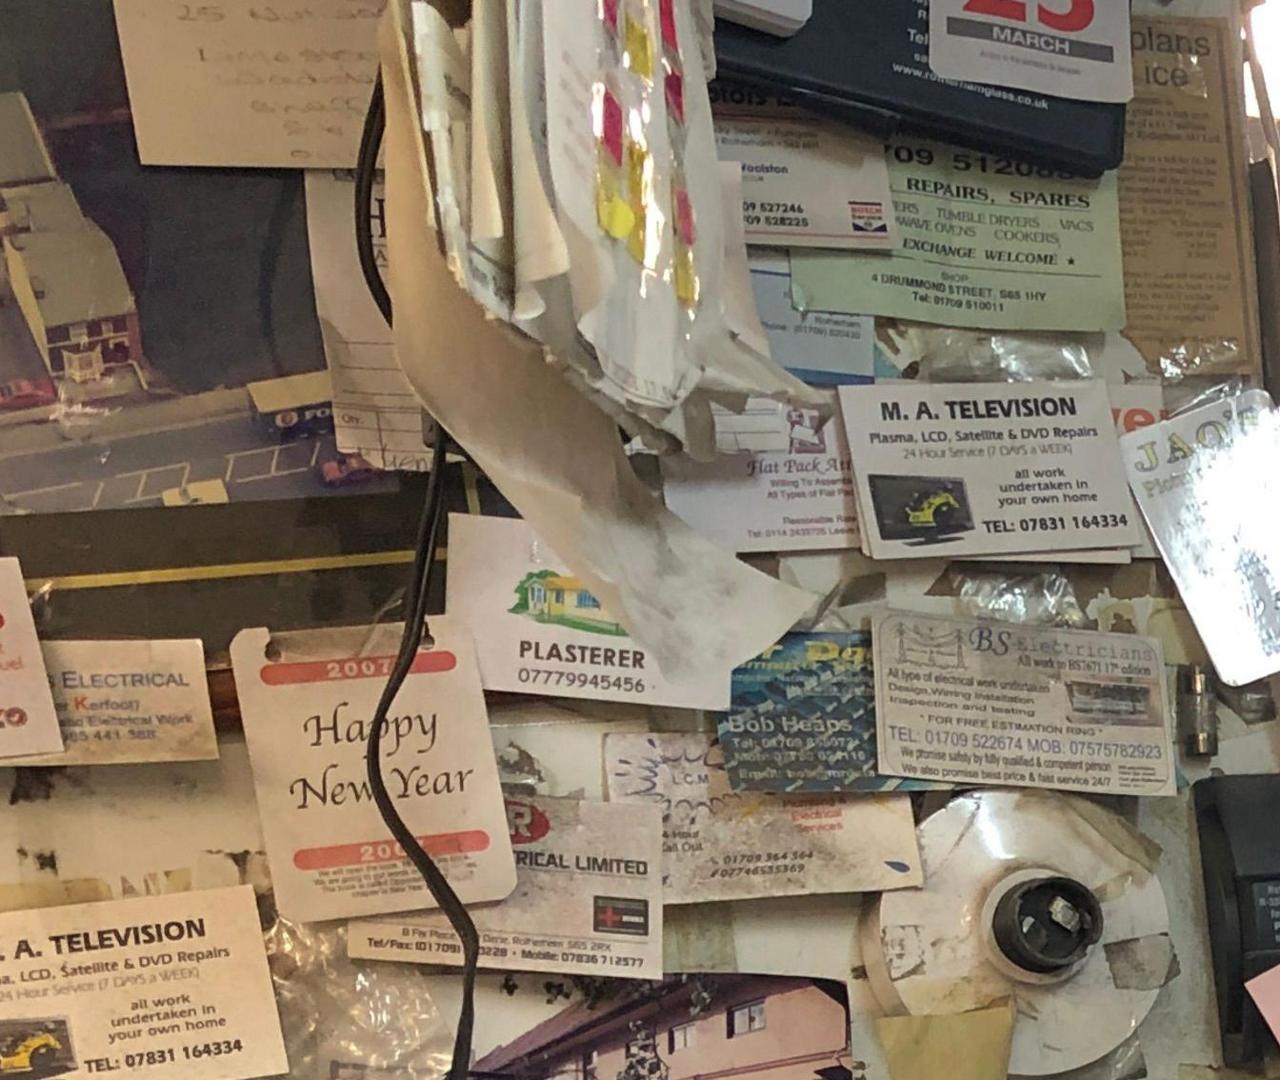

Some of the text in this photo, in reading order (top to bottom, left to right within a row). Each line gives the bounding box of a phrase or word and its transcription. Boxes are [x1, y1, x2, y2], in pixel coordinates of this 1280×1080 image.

[992, 26, 1070, 54] MARCH
[907, 177, 1090, 208] REPAIRS, SPARES
[935, 222, 976, 237] OVENS
[936, 208, 1094, 232] TUMBLE DRYERS VACS
[903, 238, 1058, 266] EXCHANGE WELCOME
[881, 273, 946, 293] DRUMMOND
[941, 272, 969, 282] SHOP
[881, 397, 1077, 421] M. A. TELEVISION
[869, 432, 917, 445] Plasma,
[956, 429, 1004, 442] Satellite
[1008, 429, 1017, 439] &
[1021, 428, 1049, 440] DVD
[1053, 426, 1098, 440] Repairs
[920, 446, 946, 459] Hour
[950, 445, 985, 458] Service
[999, 445, 1027, 457] DAYS
[1015, 467, 1065, 479] all work
[999, 479, 1088, 492] undertaken in
[998, 492, 1098, 507] your own home
[983, 514, 1128, 533] TEL: 07831 164334
[519, 640, 645, 669] PLASTERER
[969, 626, 1150, 661] BS Electricians
[326, 659, 392, 678] 2007
[518, 668, 645, 693] 07779945456
[934, 672, 974, 686] electrical
[976, 677, 998, 688] work
[962, 702, 987, 713] and
[729, 716, 852, 736] Bob Heaps
[927, 714, 1096, 737] FOR FREE ESTIMATION RING
[888, 725, 1162, 759] TEL: 01709 522674 MOB: 07575782923
[902, 764, 917, 774] We
[919, 766, 939, 776] also
[942, 767, 979, 780] promise
[981, 770, 1001, 780] best
[1004, 772, 1026, 783] price
[1057, 776, 1089, 786] service
[1092, 776, 1111, 786] 24/7
[290, 764, 474, 809] New Year
[575, 855, 648, 875] LIMITED
[14, 919, 206, 960] A. TELEVISION
[61, 961, 118, 977] Satellite
[124, 958, 134, 968] &
[139, 954, 173, 968] DVD
[178, 947, 230, 963] Repairs
[131, 994, 190, 1011] all work
[111, 1004, 216, 1028] undertaken in
[108, 1017, 226, 1044] your own home
[84, 1039, 243, 1074] TEL: 07831 164334
